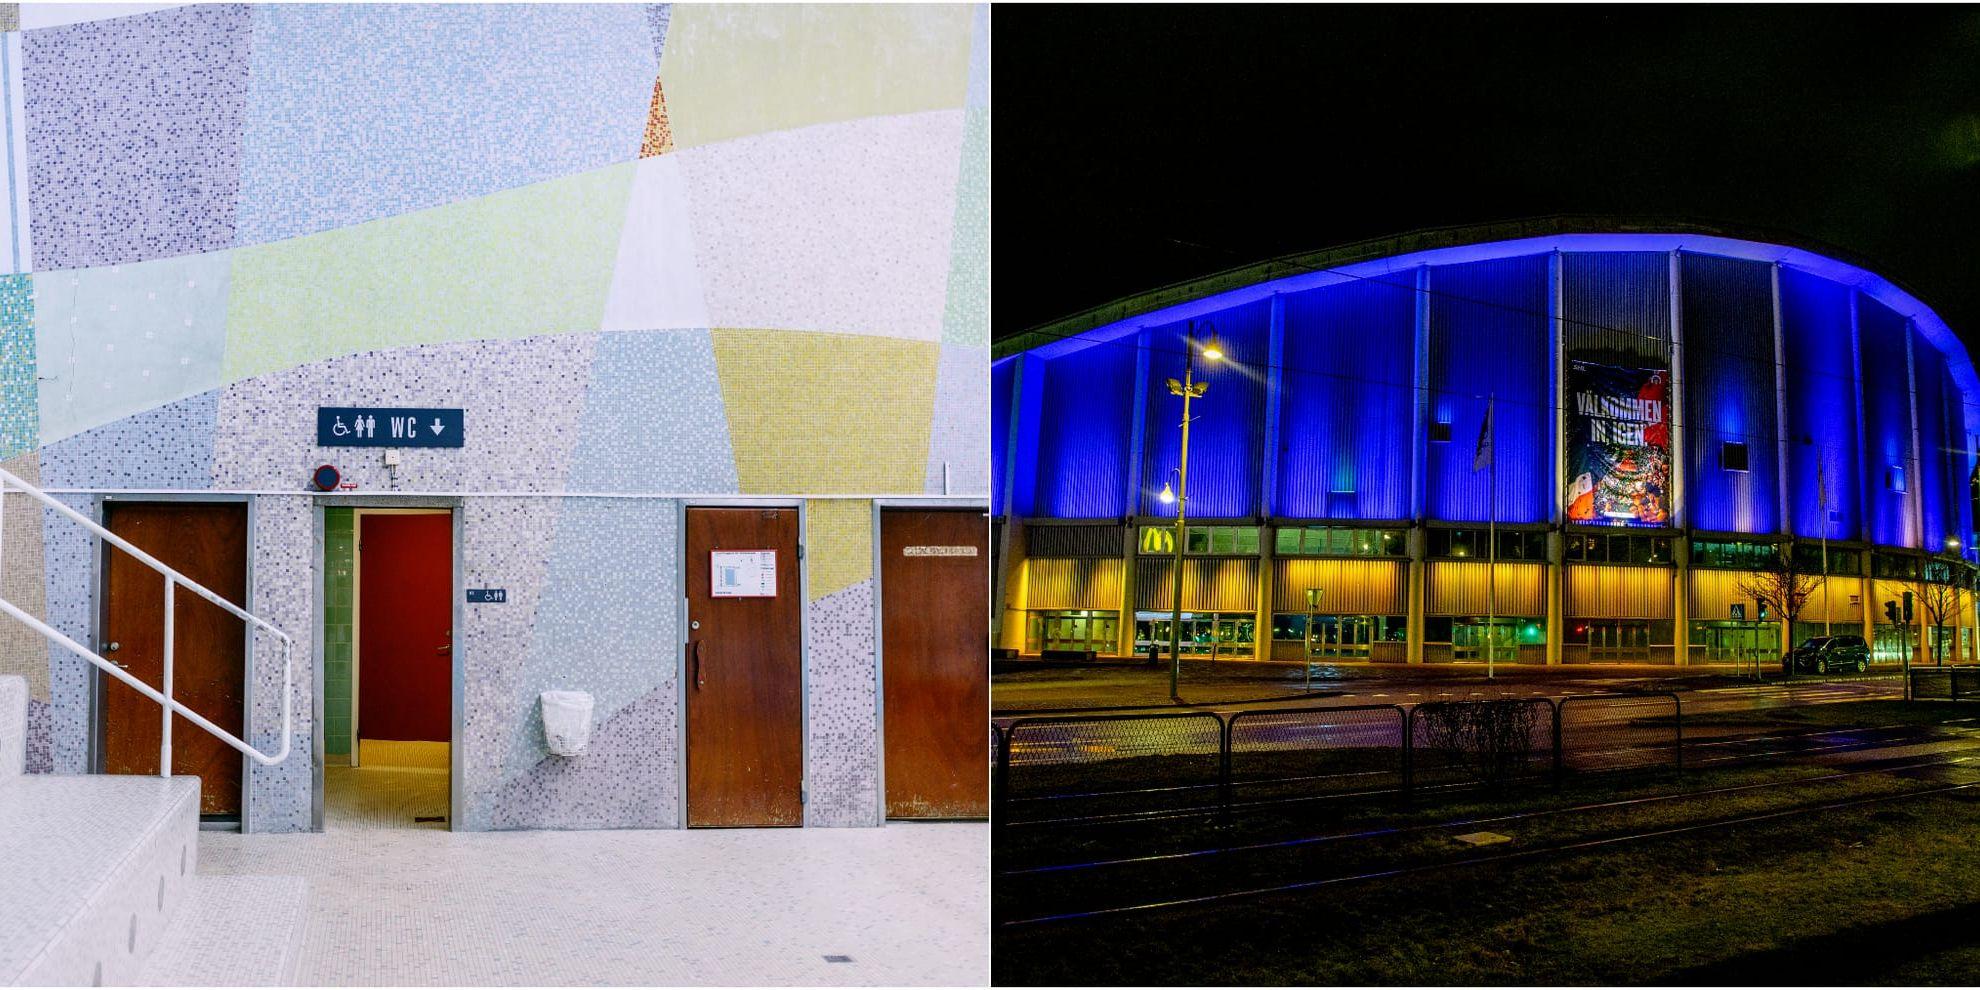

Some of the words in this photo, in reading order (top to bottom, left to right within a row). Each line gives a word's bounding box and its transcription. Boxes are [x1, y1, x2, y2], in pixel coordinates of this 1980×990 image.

[1577, 390, 1662, 423] VÄLKOMMEN
[391, 417, 417, 438] WC
[1613, 421, 1648, 446] IGEN.
